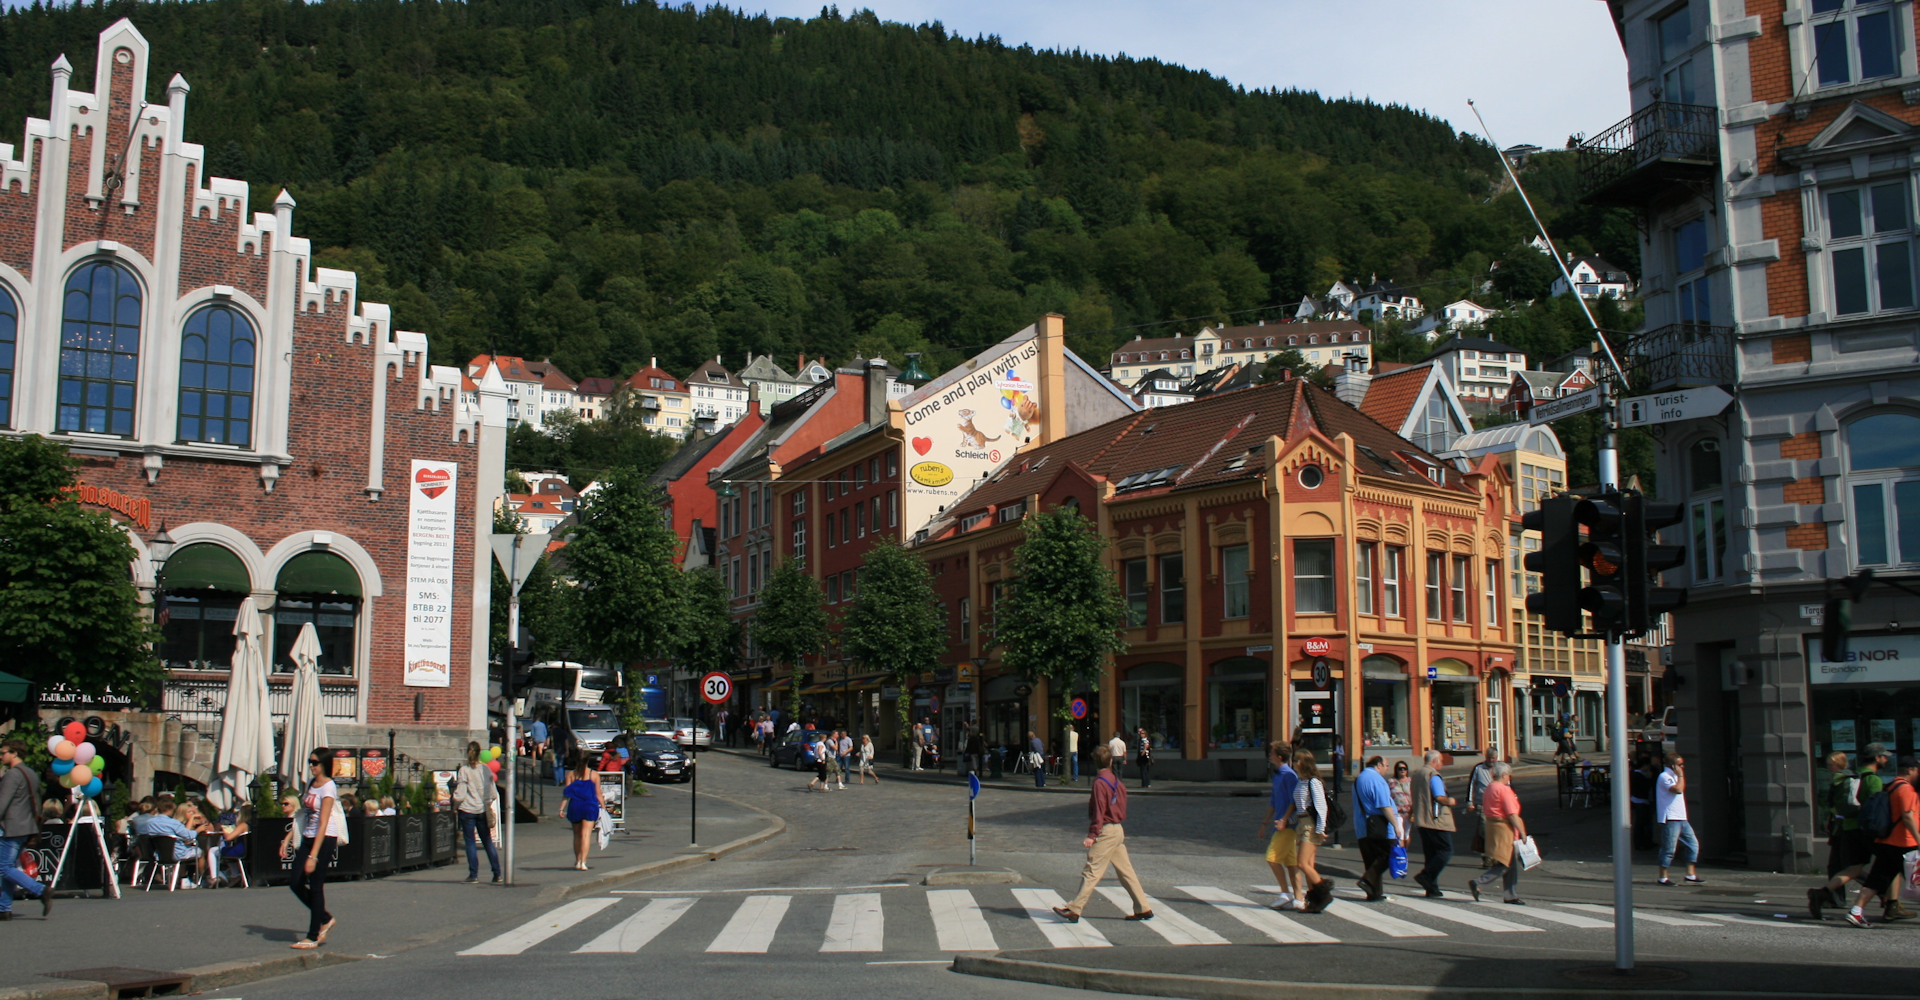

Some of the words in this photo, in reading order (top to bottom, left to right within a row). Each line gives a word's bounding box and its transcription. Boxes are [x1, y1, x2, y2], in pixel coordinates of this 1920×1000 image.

[904, 400, 941, 425] Come
[942, 383, 967, 406] and
[966, 370, 994, 395] play
[993, 353, 1021, 376] with
[1020, 341, 1040, 360] us!
[1654, 393, 1688, 407] Turist-
[1661, 408, 1682, 420] info
[955, 449, 989, 460] Schleich
[907, 488, 958, 496] www.rubens.no
[427, 576, 436, 584] PÅ
[418, 591, 440, 600] SMS:
[412, 603, 434, 612] BTBB
[436, 605, 447, 613] 22
[1804, 606, 1824, 615] Torge
[413, 614, 422, 623] til
[423, 615, 444, 624] 2077
[1306, 641, 1328, 649] B&M
[1859, 650, 1899, 661] NOR
[1315, 667, 1326, 682] 30
[1821, 665, 1867, 674] Eiendom
[707, 680, 727, 695] 30
[81, 694, 94, 703] BA
[102, 694, 131, 704] UTSALG
